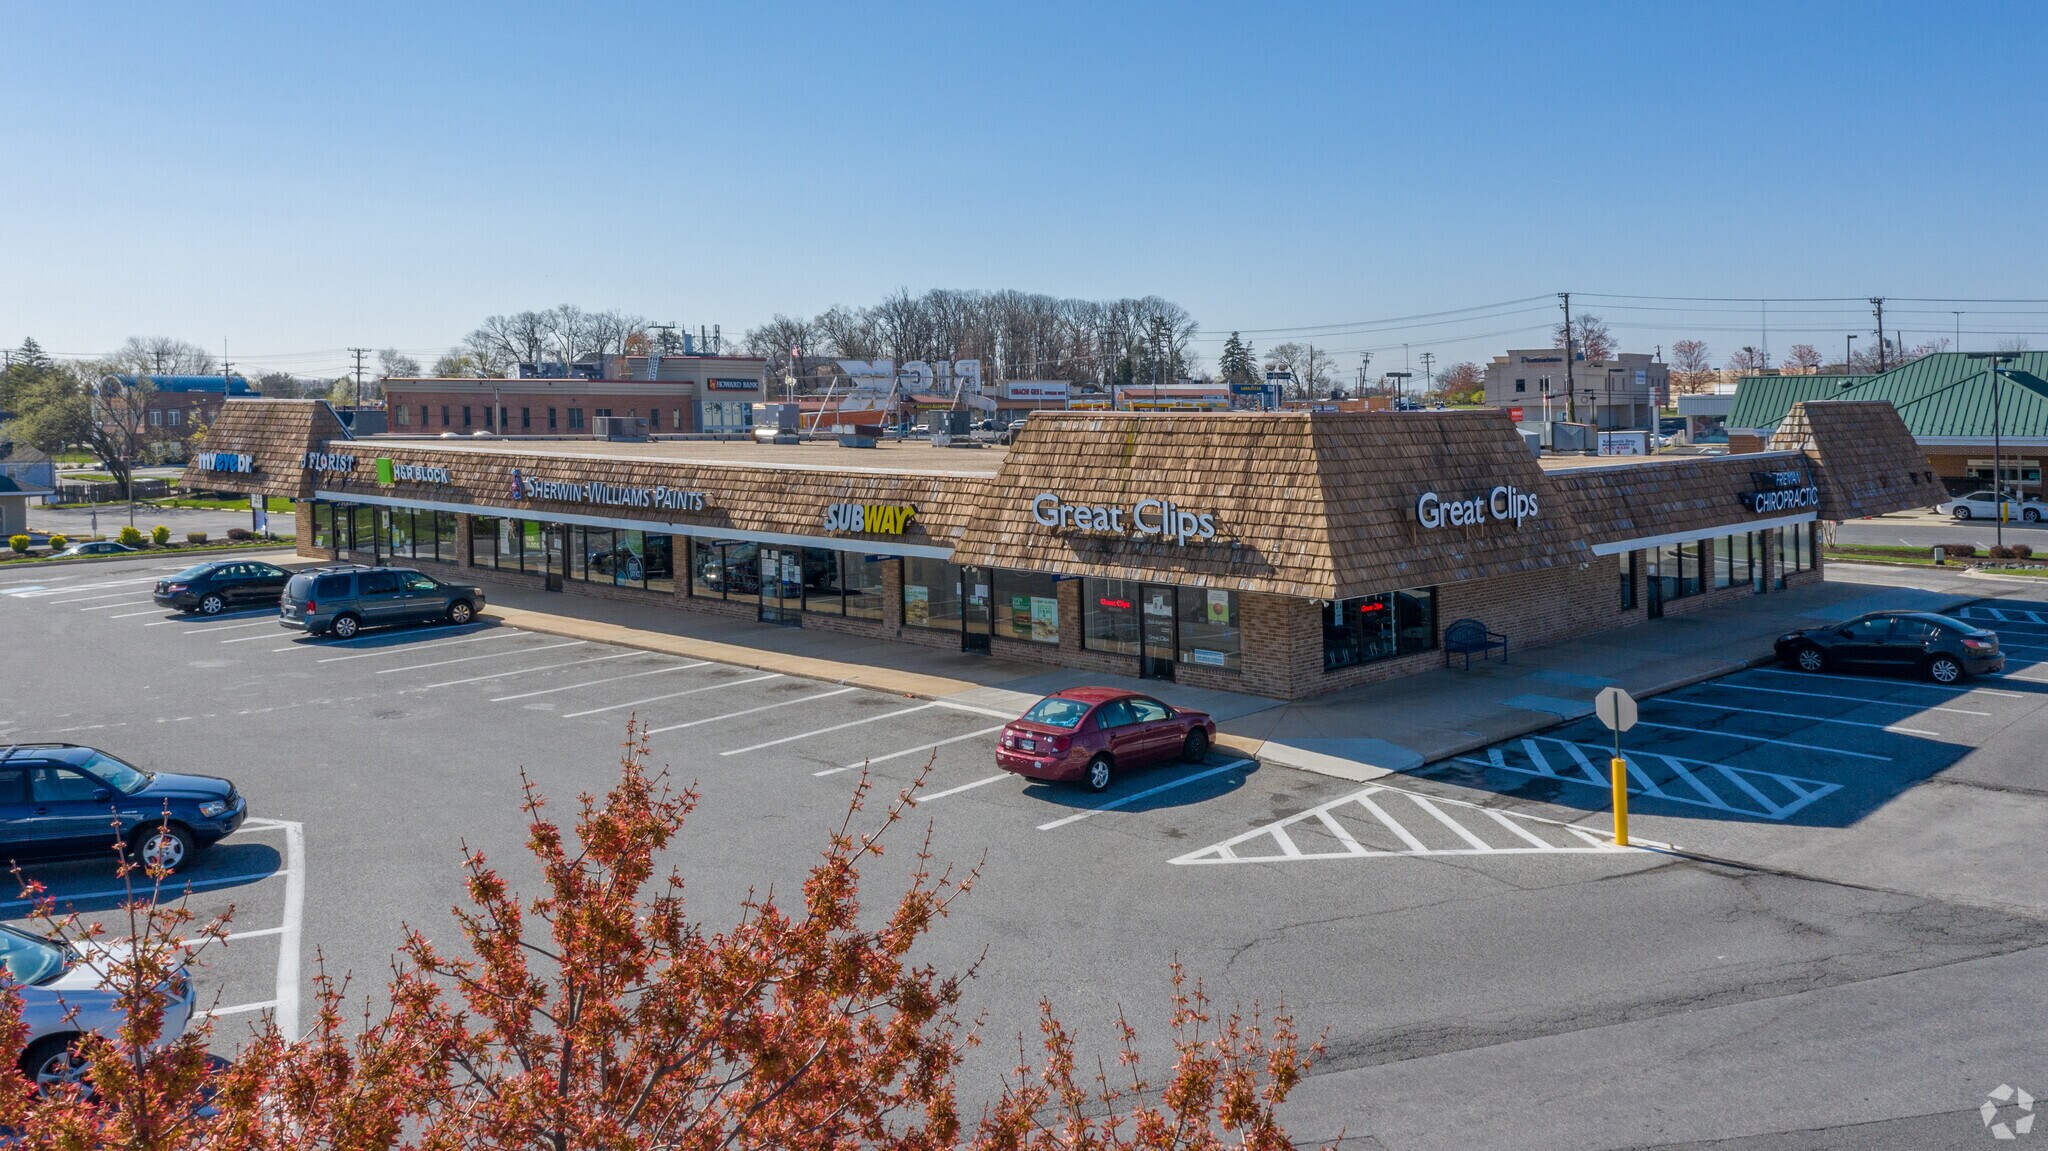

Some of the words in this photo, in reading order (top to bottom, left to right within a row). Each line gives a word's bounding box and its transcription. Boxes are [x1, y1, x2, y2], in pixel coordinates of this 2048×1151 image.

[716, 381, 742, 389] HOWARD
[743, 381, 759, 389] BANK
[309, 453, 355, 472] FLORIST
[393, 464, 413, 480] H&R
[415, 466, 449, 484] BLOCK
[527, 476, 650, 509] SHERWIN-WILLIAMS
[655, 485, 703, 511] PAINTS
[1416, 492, 1486, 529] Great
[1488, 485, 1539, 528] Clips
[1755, 486, 1819, 514] CHIROPRACTIC
[823, 503, 916, 535] SUBWAY
[1032, 493, 1125, 533] Great
[1133, 499, 1217, 547] Clips
